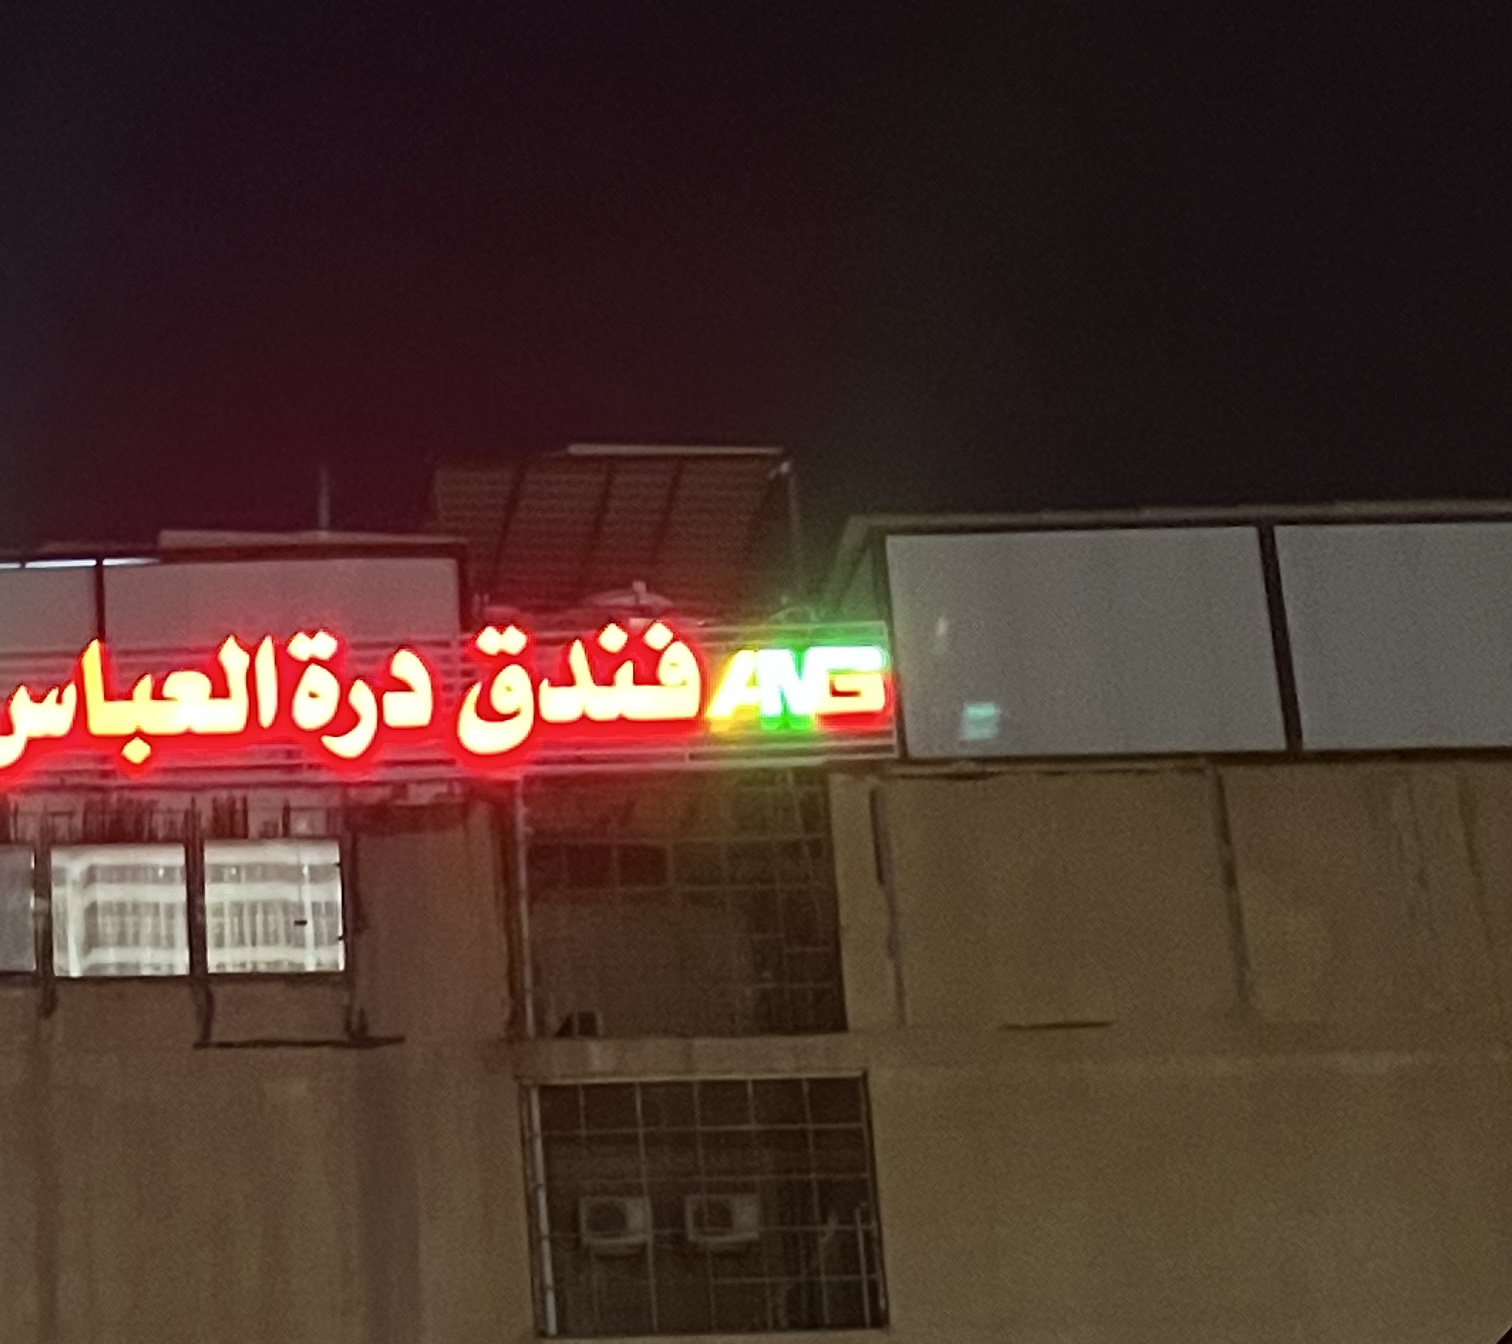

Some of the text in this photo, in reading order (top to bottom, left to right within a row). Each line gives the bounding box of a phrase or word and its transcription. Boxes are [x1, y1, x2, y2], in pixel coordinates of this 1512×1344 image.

[286, 629, 434, 759] درة
[456, 621, 701, 755] فندق
[704, 644, 887, 722] ANG
